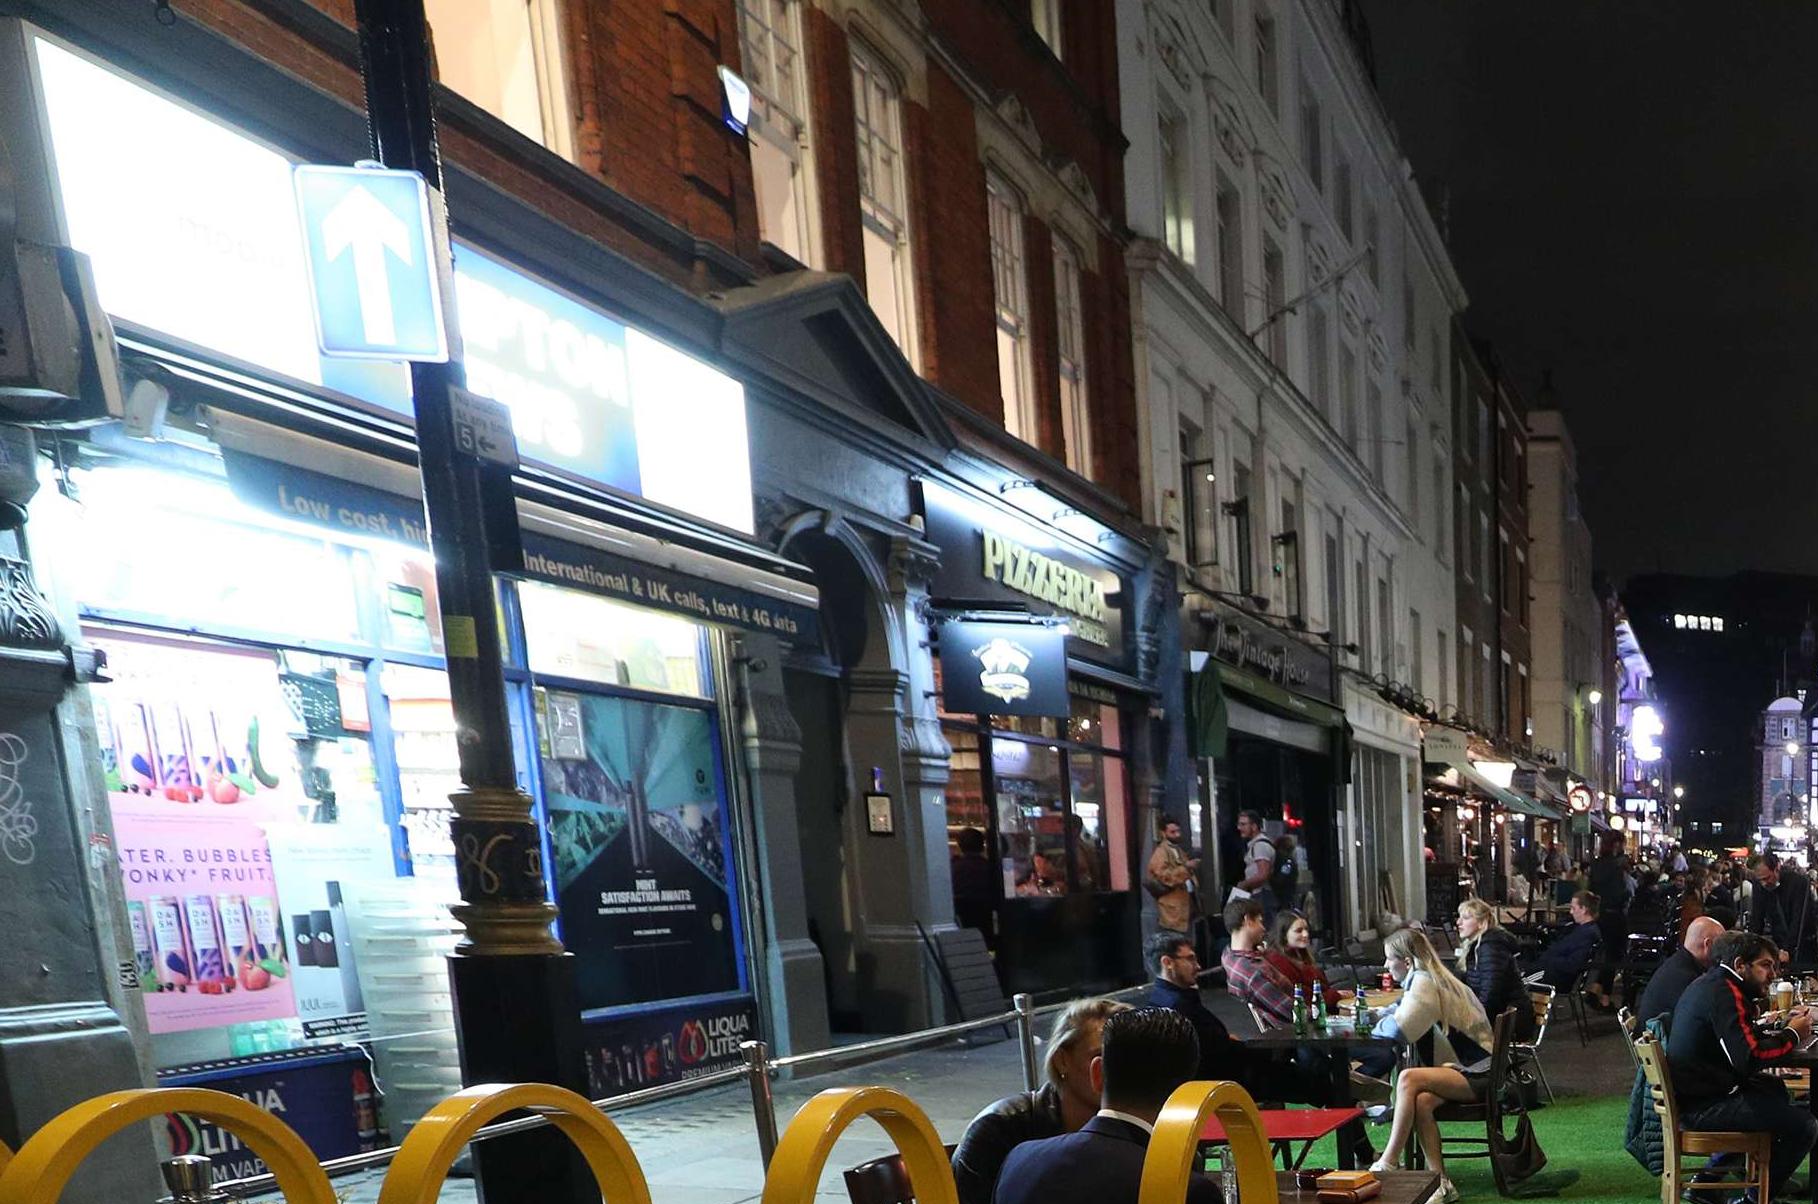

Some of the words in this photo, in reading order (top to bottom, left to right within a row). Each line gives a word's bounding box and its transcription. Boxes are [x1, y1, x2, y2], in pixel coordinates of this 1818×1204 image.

[462, 427, 474, 449] 5
[278, 485, 331, 521] Low
[338, 506, 398, 540] cost,
[523, 549, 629, 593] International
[631, 576, 643, 598] &
[647, 580, 671, 603] UK
[674, 590, 711, 616] calls,
[713, 598, 740, 620] text
[752, 607, 770, 628] 4G
[774, 613, 798, 634] data
[117, 849, 174, 863] TER.
[184, 848, 272, 863] BUBBLES
[120, 868, 198, 883] ONKY
[209, 867, 273, 882] FRUIT.
[601, 891, 660, 905] SATISFACTION
[661, 889, 691, 901] AWAITS
[708, 1014, 749, 1037] LIQUA
[710, 1035, 744, 1058] LITES
